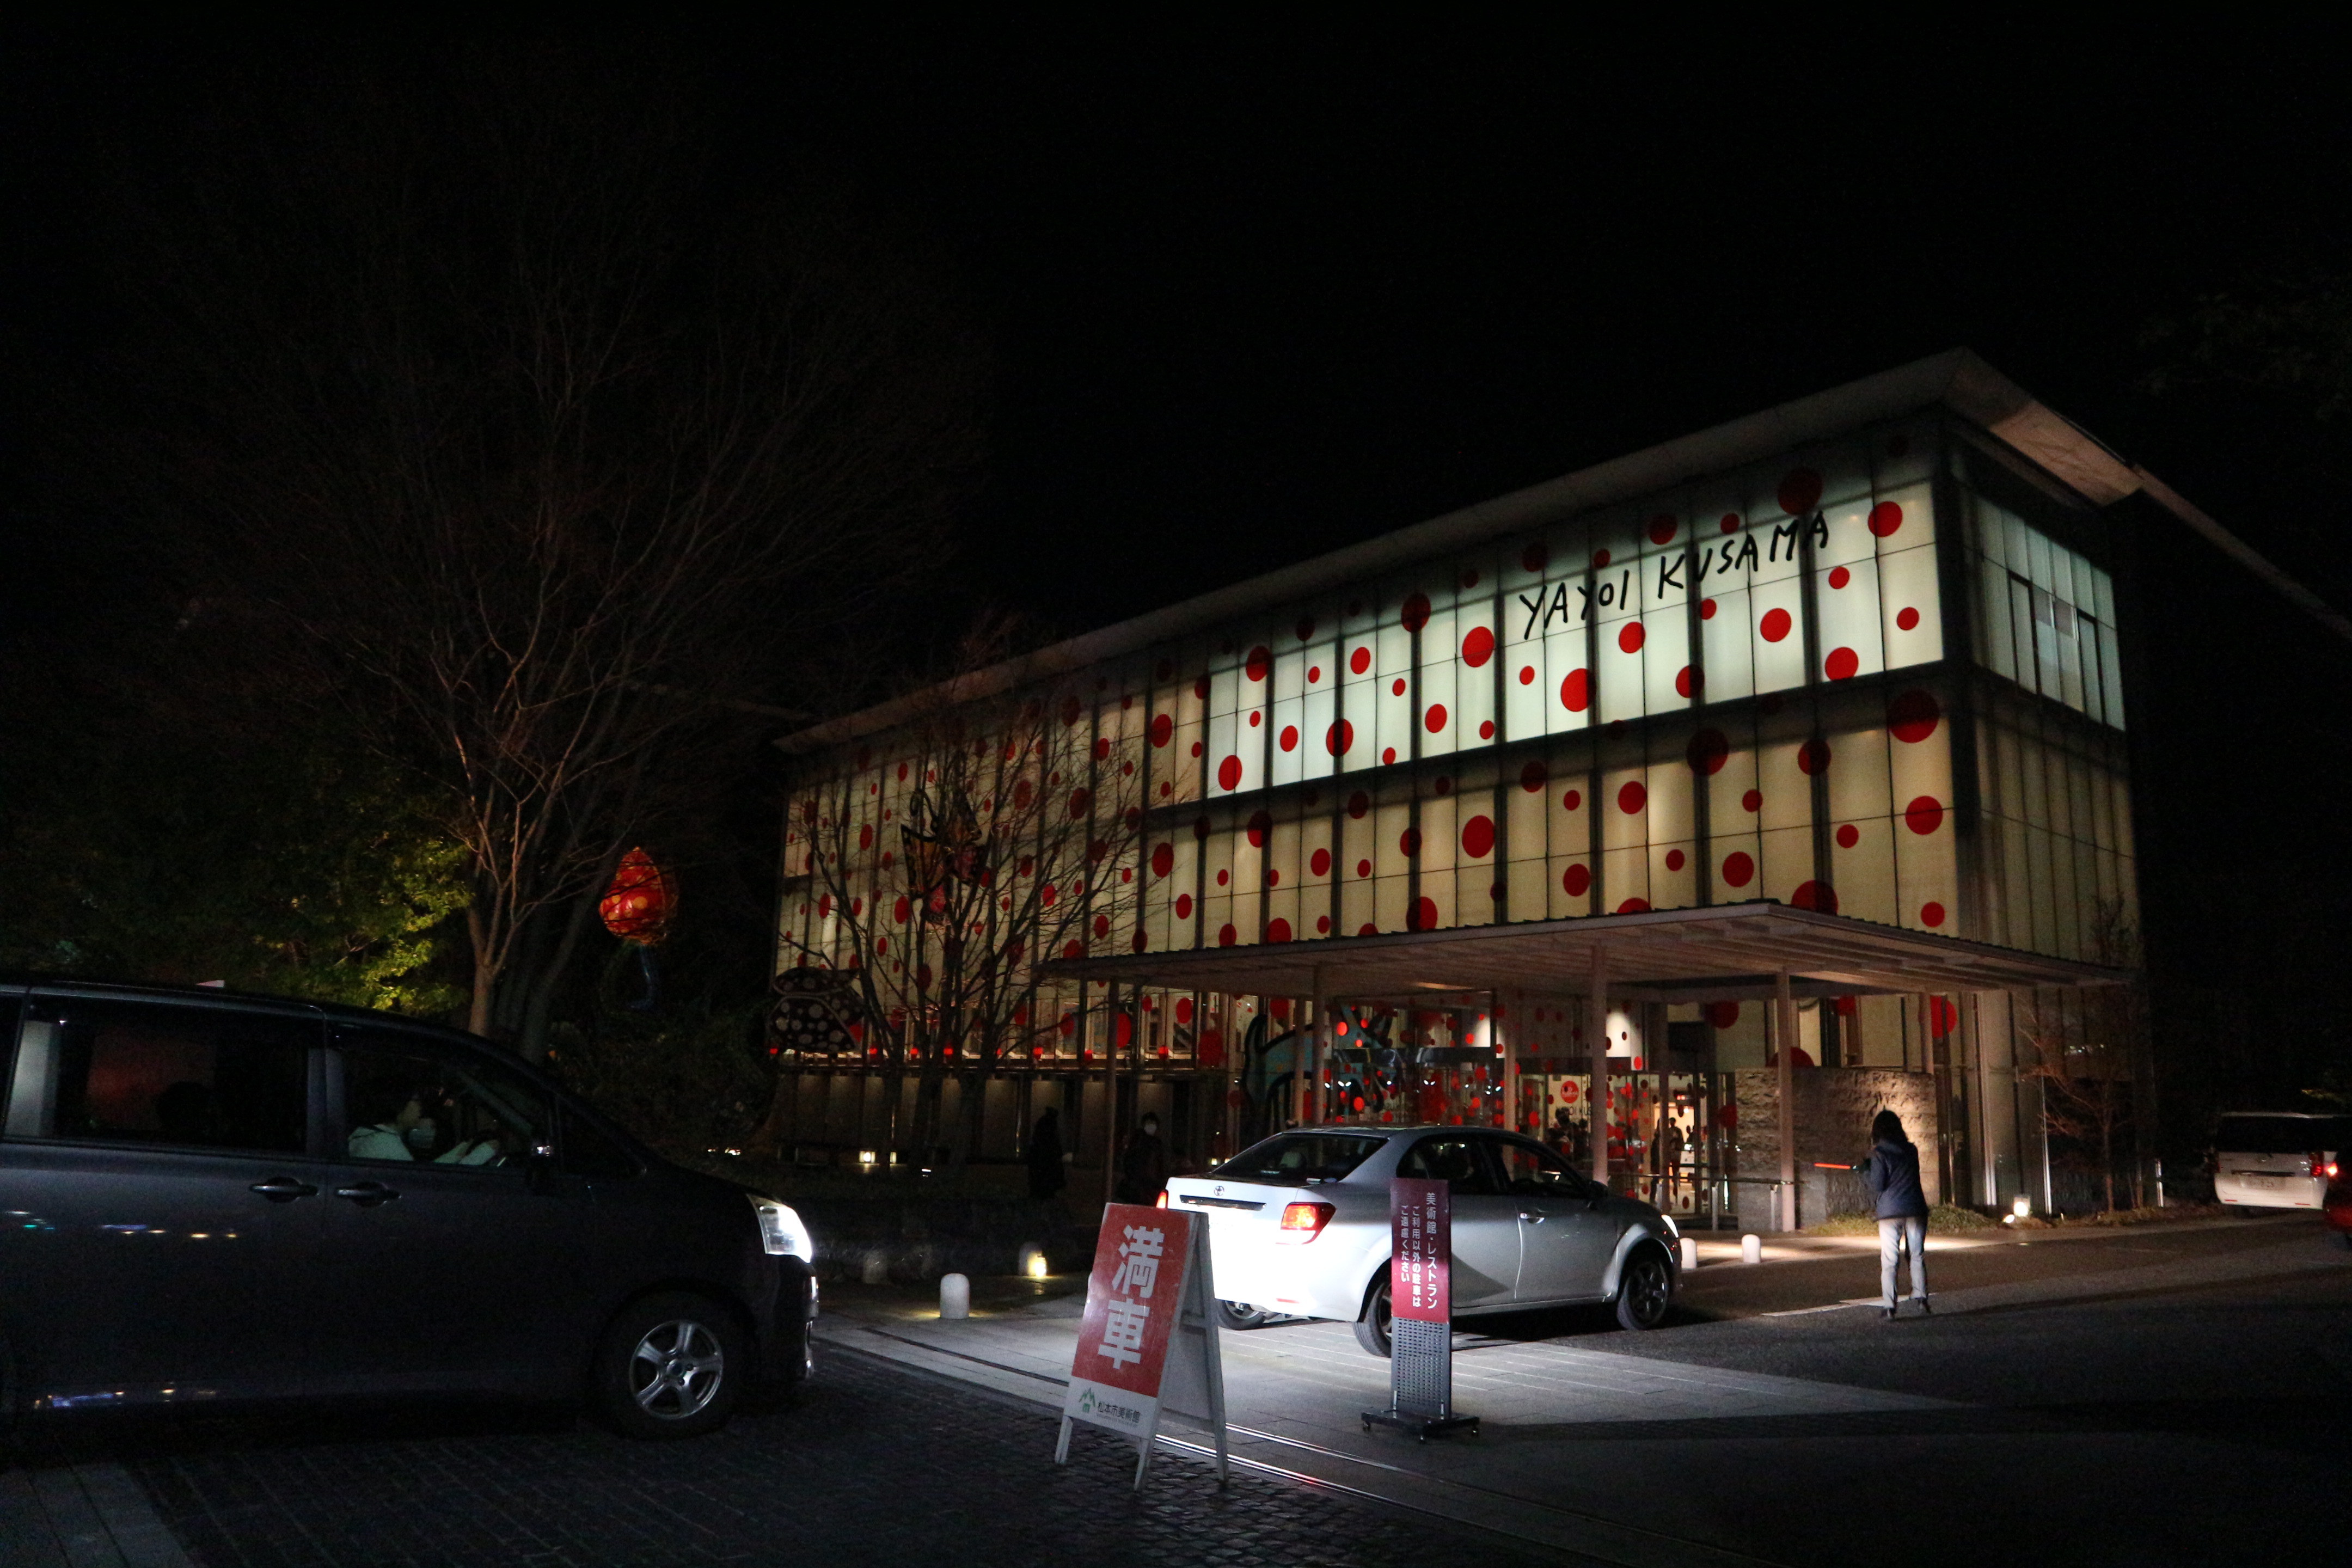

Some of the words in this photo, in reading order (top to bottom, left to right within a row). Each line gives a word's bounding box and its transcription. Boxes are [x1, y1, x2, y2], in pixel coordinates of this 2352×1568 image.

[1519, 569, 1630, 640] YAYOI
[1658, 511, 1828, 599] KUSAMA
[1401, 1205, 1410, 1282] ご遠慮ください
[1412, 1206, 1421, 1307] ご利用以外の駐車は
[1098, 1224, 1165, 1369] 満車
[1098, 1401, 1141, 1423] 松本市美術館
